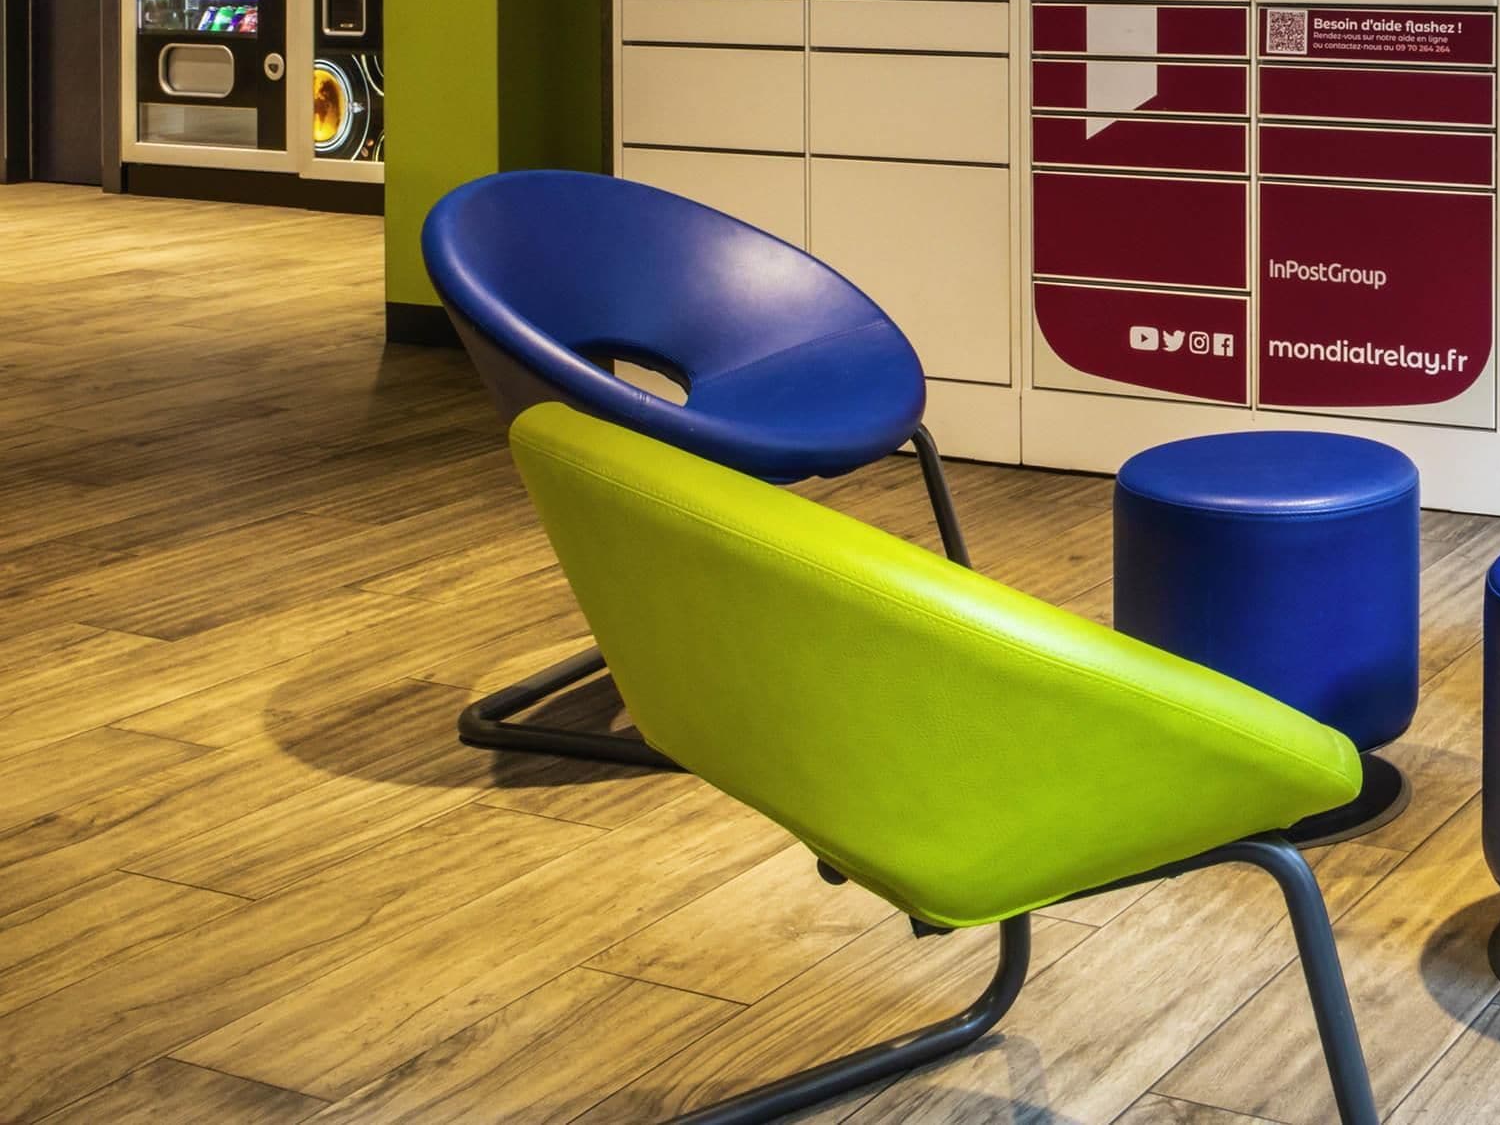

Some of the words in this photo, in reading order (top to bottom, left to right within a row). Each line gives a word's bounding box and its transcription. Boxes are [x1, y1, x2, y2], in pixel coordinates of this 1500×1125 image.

[1313, 18, 1358, 31] Besoin
[1361, 18, 1403, 32] d'aide
[1405, 20, 1455, 34] flashez
[1457, 21, 1463, 34] !
[1313, 32, 1361, 41] Rendez-vous
[1376, 33, 1396, 42] notre
[1397, 34, 1415, 43] aide
[1428, 35, 1448, 44] ligne
[1324, 42, 1383, 51] contactez-nous
[1395, 44, 1406, 52] 09
[1407, 44, 1418, 52] 70
[1419, 44, 1434, 53] 264
[1435, 45, 1451, 53] 264
[1269, 259, 1387, 290] InPostGroup
[1268, 339, 1468, 375] mondialrelay.fr
